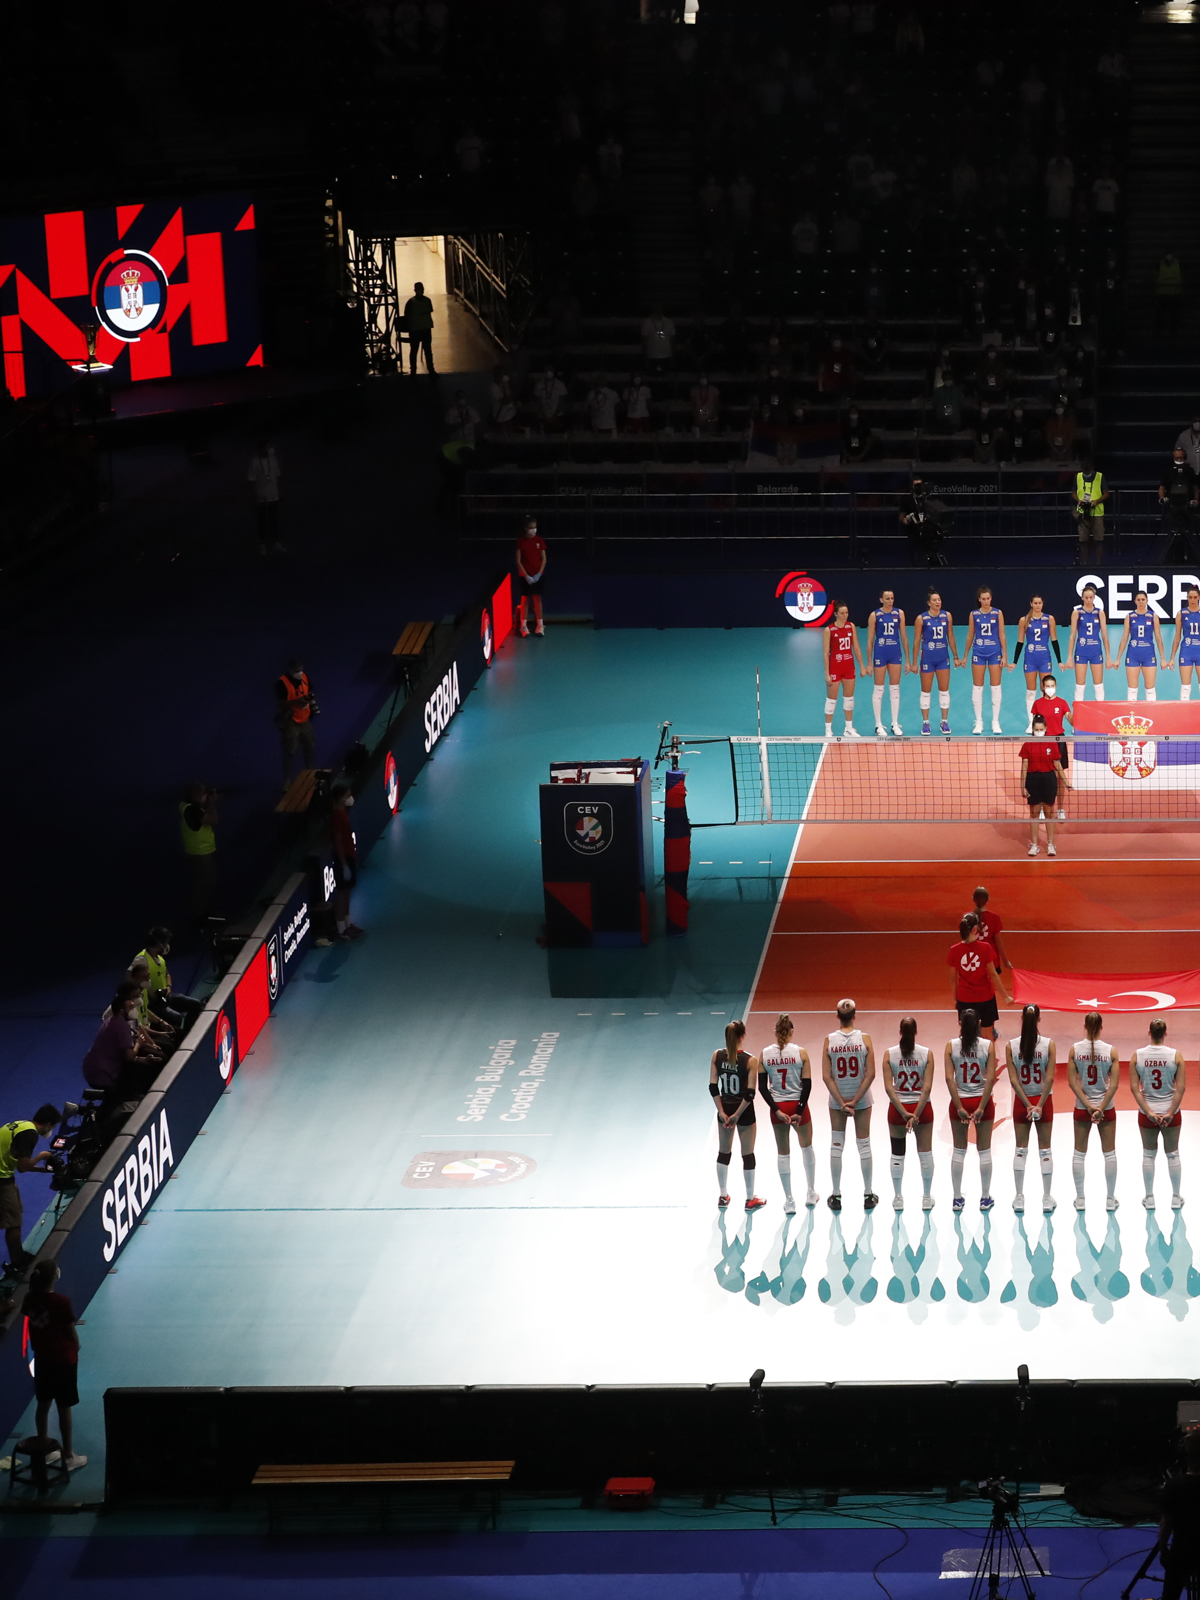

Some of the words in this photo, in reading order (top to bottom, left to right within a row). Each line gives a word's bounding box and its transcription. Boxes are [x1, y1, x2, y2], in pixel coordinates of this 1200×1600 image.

[933, 485, 977, 493] EuroVolley
[979, 485, 998, 493] 2021
[883, 622, 895, 635] 16
[932, 626, 944, 639] 19
[981, 623, 992, 636] 21
[1034, 628, 1041, 641] 2
[1086, 622, 1093, 635] 3
[1137, 625, 1145, 637] 8
[1189, 622, 1200, 635] 11
[839, 637, 851, 651] 20
[424, 661, 460, 753] SERBIA
[577, 806, 599, 814] CEV
[518, 1032, 560, 1076] Romania
[830, 1044, 863, 1054] KARAKURT
[475, 1039, 517, 1082] Bulgaria
[766, 1057, 796, 1066] BALADIN
[836, 1056, 859, 1078] 99
[1144, 1058, 1167, 1067] ÖZBAY
[777, 1068, 788, 1090] 7
[897, 1071, 921, 1092] 22
[959, 1061, 981, 1083] 12
[1020, 1063, 1042, 1085] 95
[1087, 1064, 1098, 1086] 9
[1151, 1069, 1163, 1090] 3
[720, 1072, 740, 1095] 10
[457, 1084, 502, 1122] Serbia,
[500, 1078, 546, 1122] Croatia,
[413, 1160, 436, 1179] CEV
[101, 1107, 174, 1262] SERBIA
